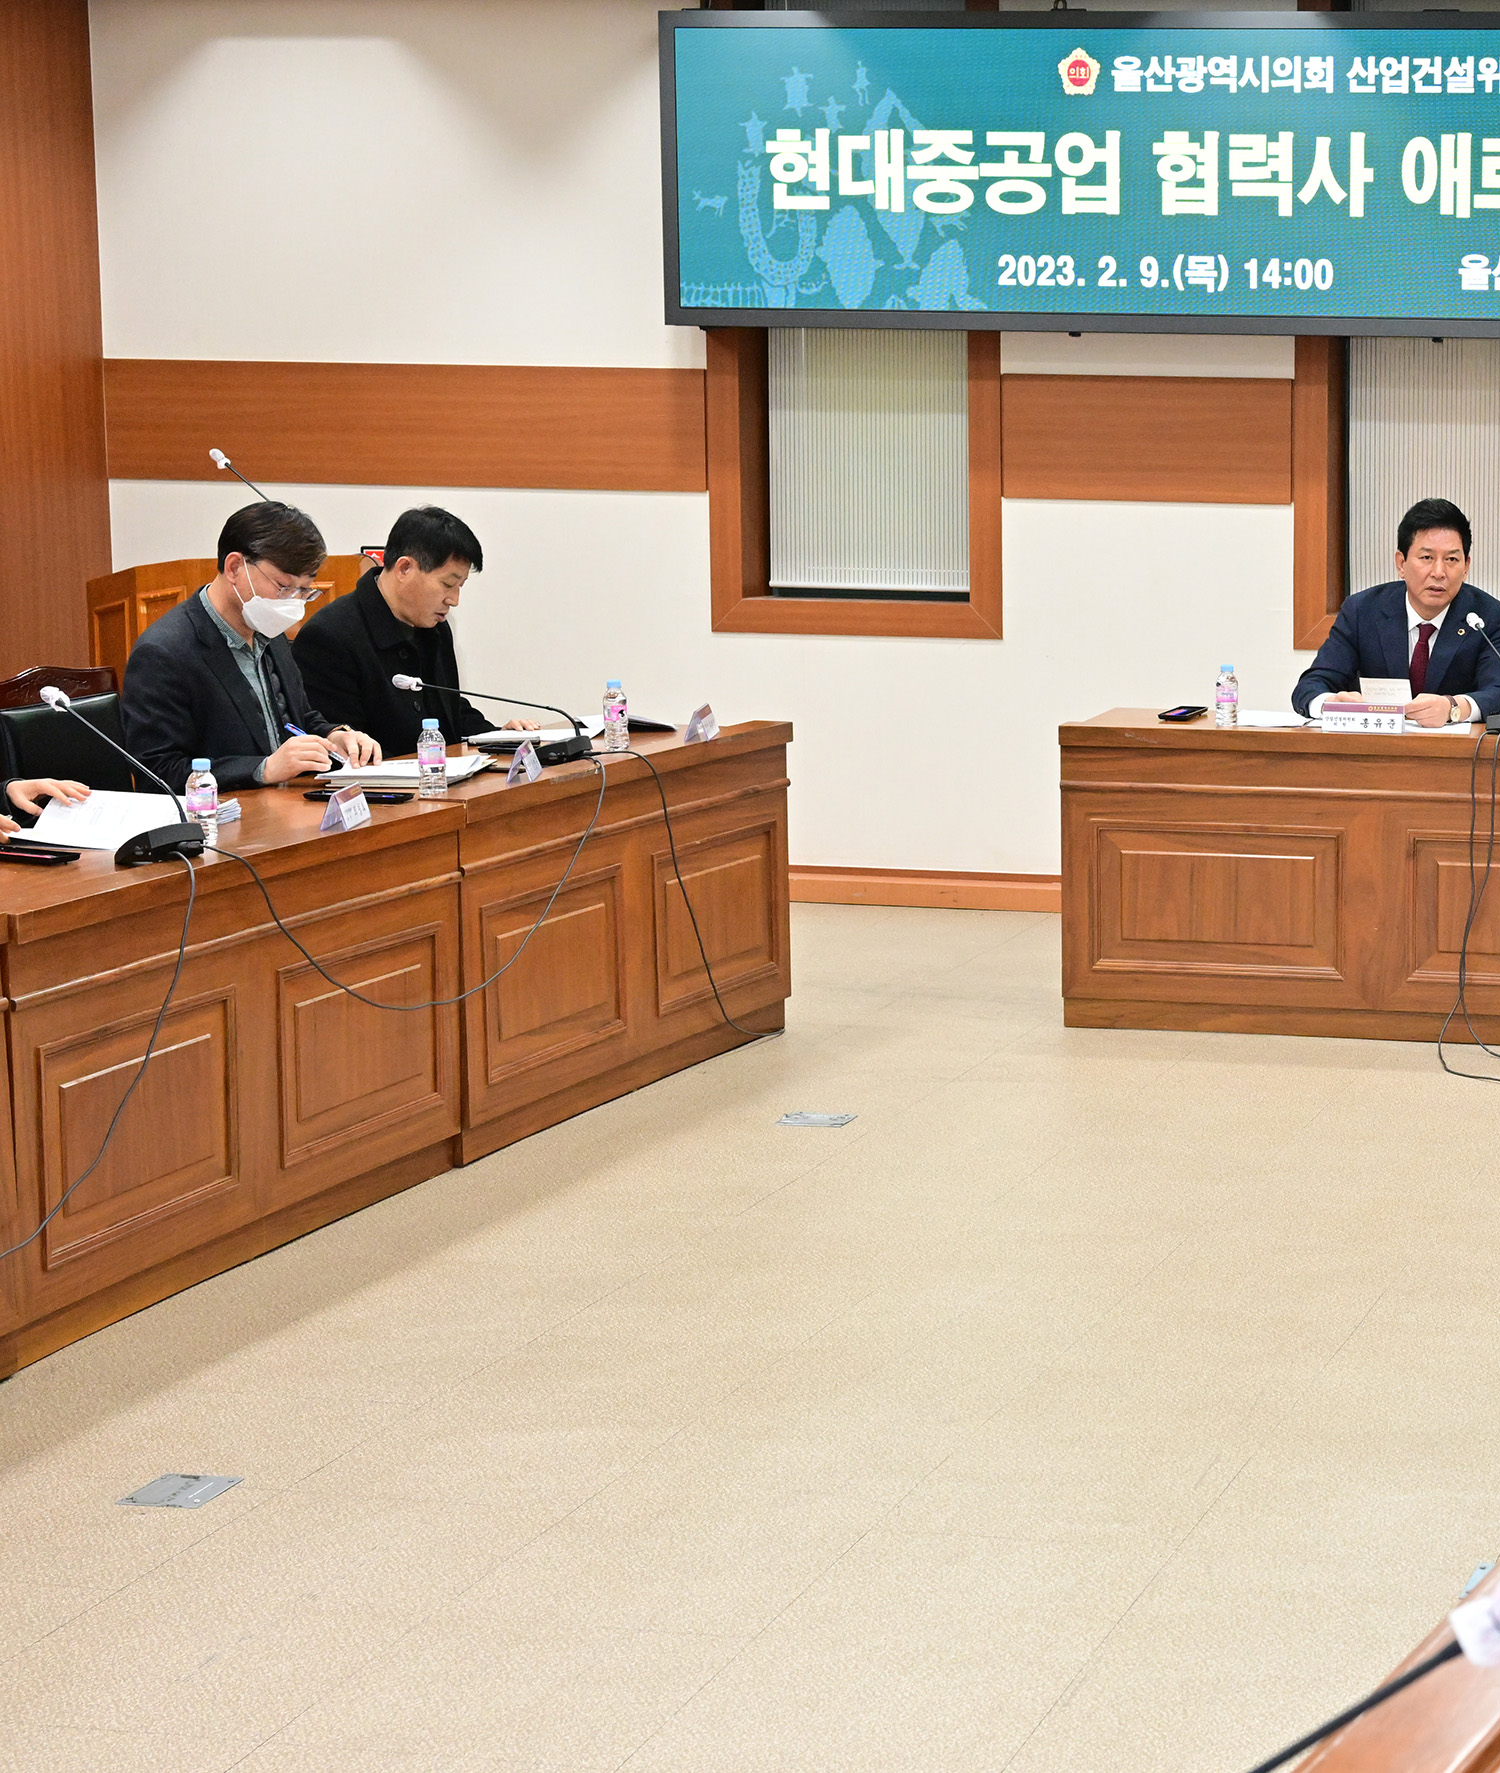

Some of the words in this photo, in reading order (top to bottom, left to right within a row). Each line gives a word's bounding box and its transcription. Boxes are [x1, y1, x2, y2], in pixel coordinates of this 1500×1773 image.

[1069, 67, 1091, 80] 의회
[1111, 55, 1334, 93] 울산광역시의회
[766, 128, 1121, 215] 현대중공업
[1152, 130, 1373, 217] 협력사
[997, 254, 1086, 287] 2023.
[1098, 255, 1127, 287] 2.
[1139, 253, 1229, 293] 9.(목)
[1244, 257, 1334, 290] 14:00
